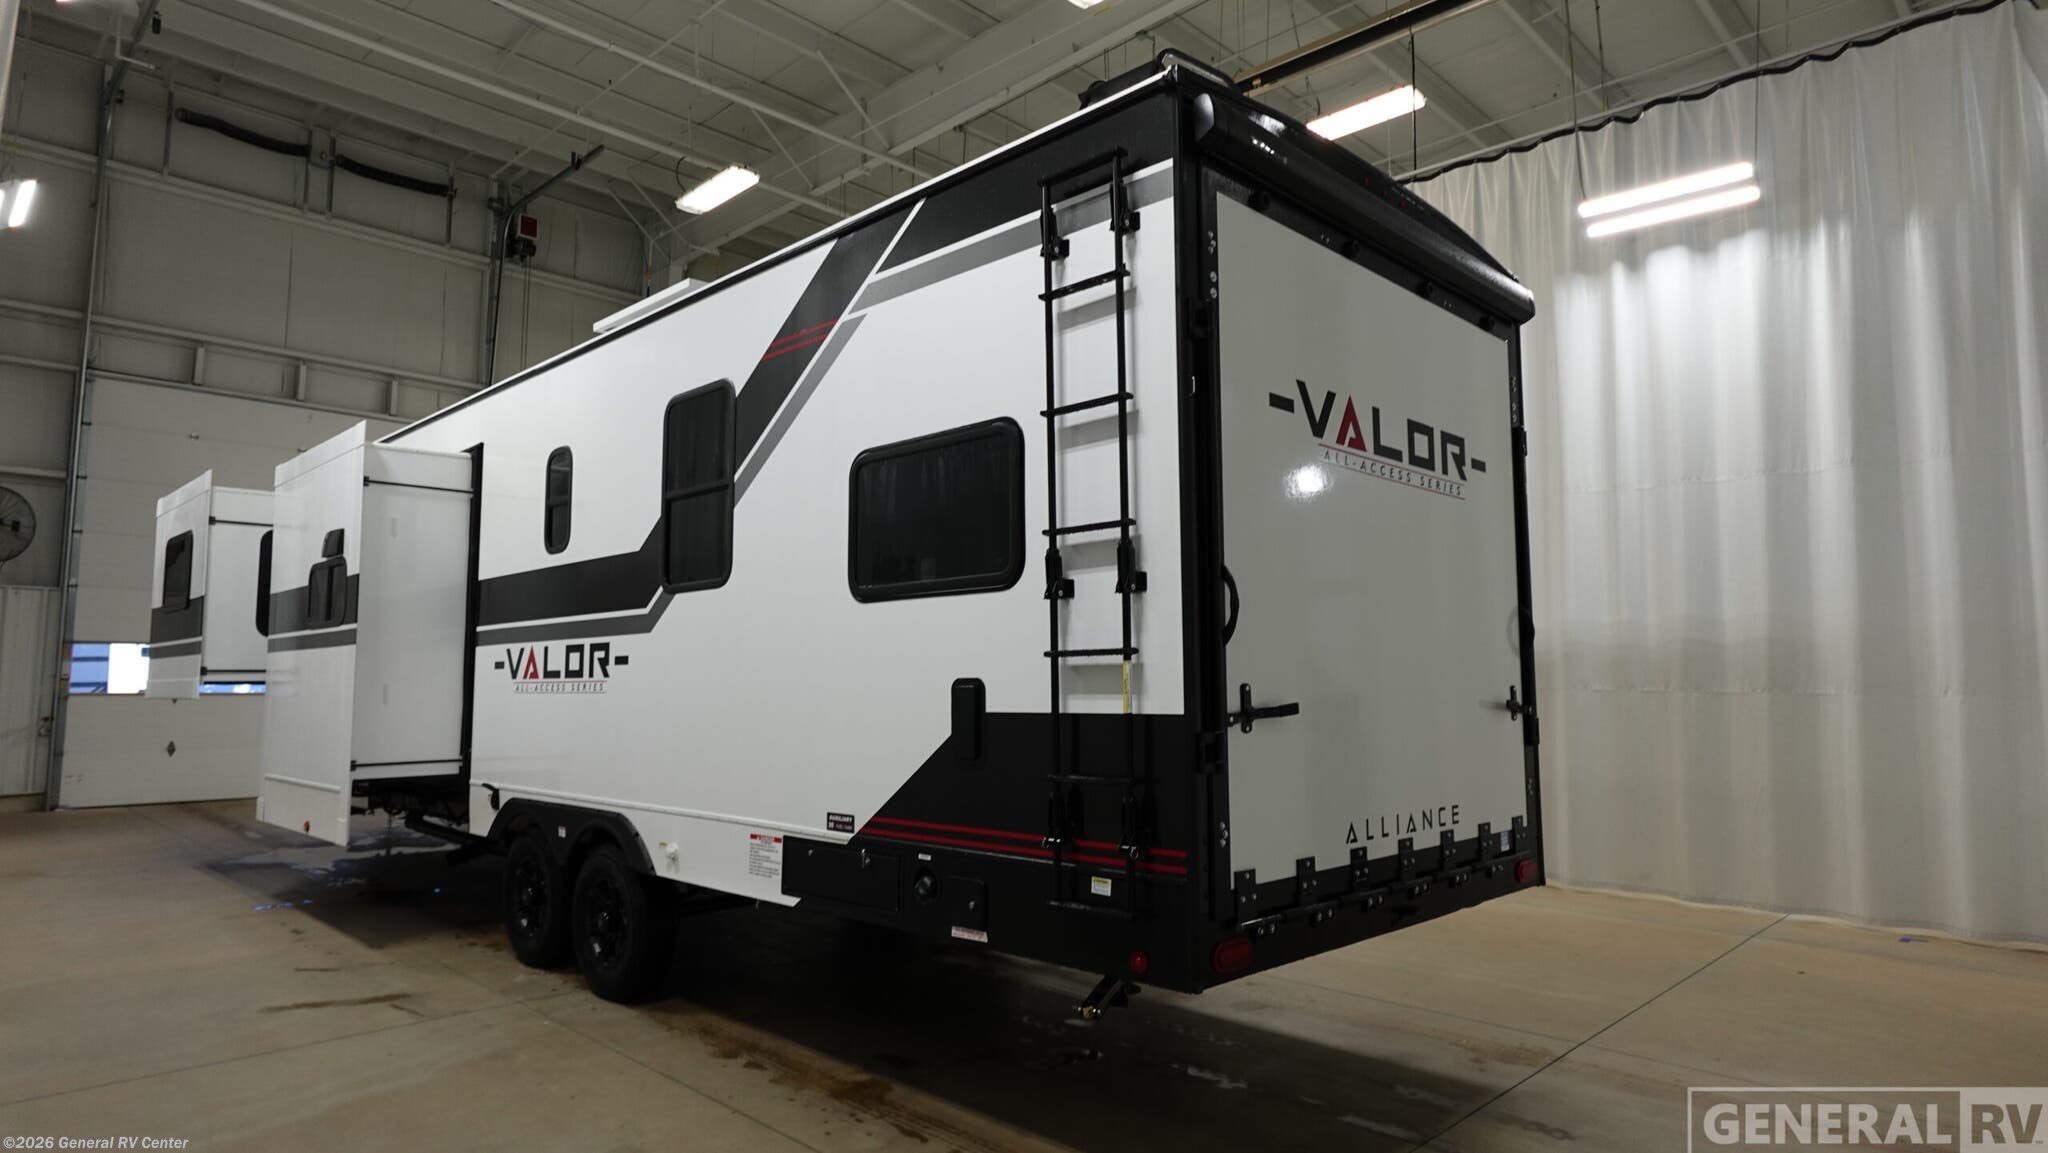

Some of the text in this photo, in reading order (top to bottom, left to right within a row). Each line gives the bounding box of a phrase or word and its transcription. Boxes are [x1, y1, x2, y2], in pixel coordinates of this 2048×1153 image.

[1323, 450, 1462, 496] ALL-ACCESS SERIES
[571, 683, 604, 692] SERIES
[1346, 805, 1459, 844] ALLIANCE
